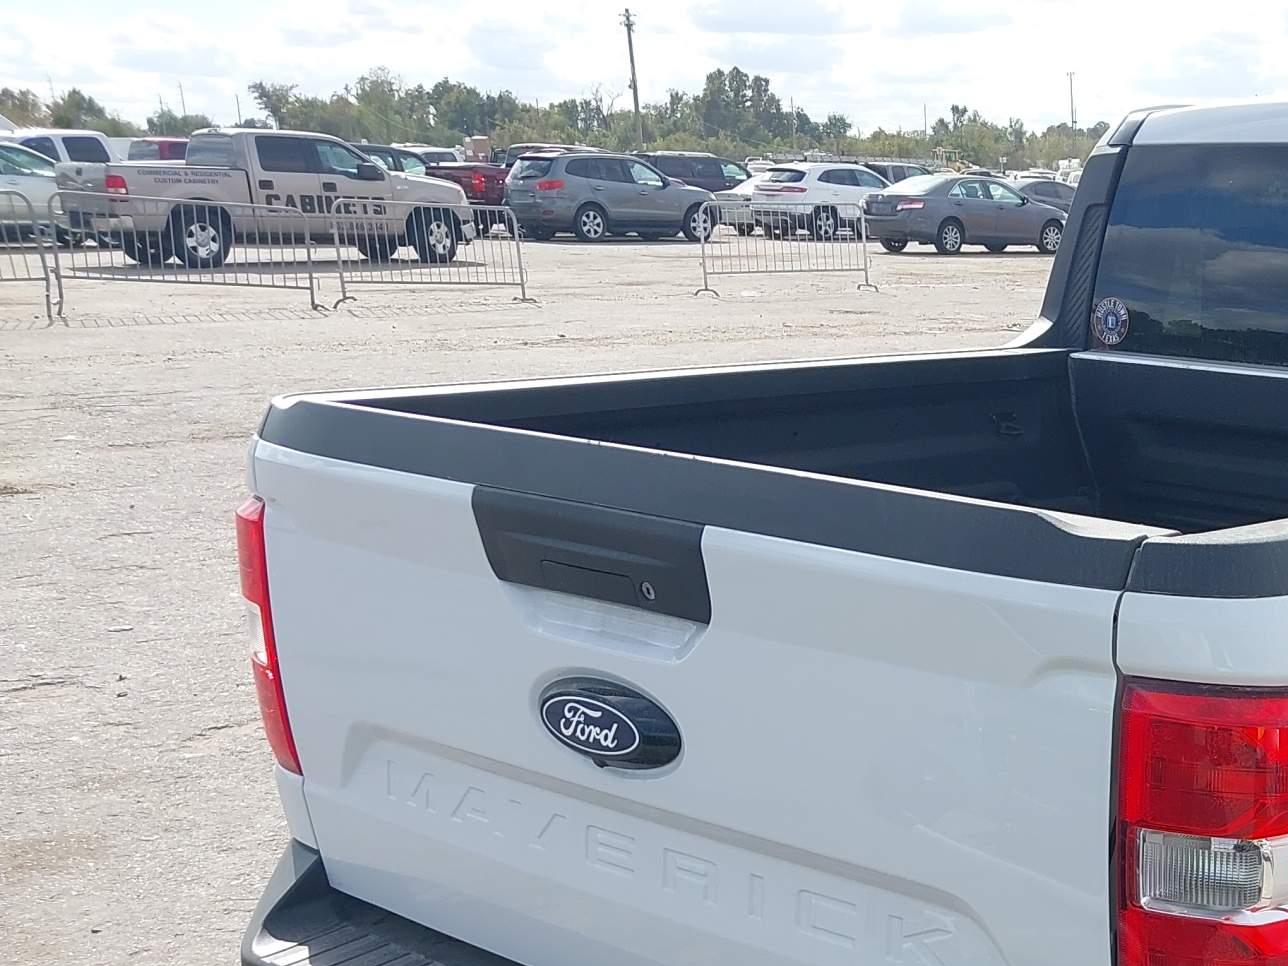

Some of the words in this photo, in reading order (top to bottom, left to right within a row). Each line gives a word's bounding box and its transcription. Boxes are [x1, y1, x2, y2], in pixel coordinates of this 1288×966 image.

[1096, 299, 1115, 318] HUSTLE
[1115, 301, 1128, 321] TOWN
[1102, 332, 1120, 345] TEXAS
[560, 702, 619, 748] Ford
